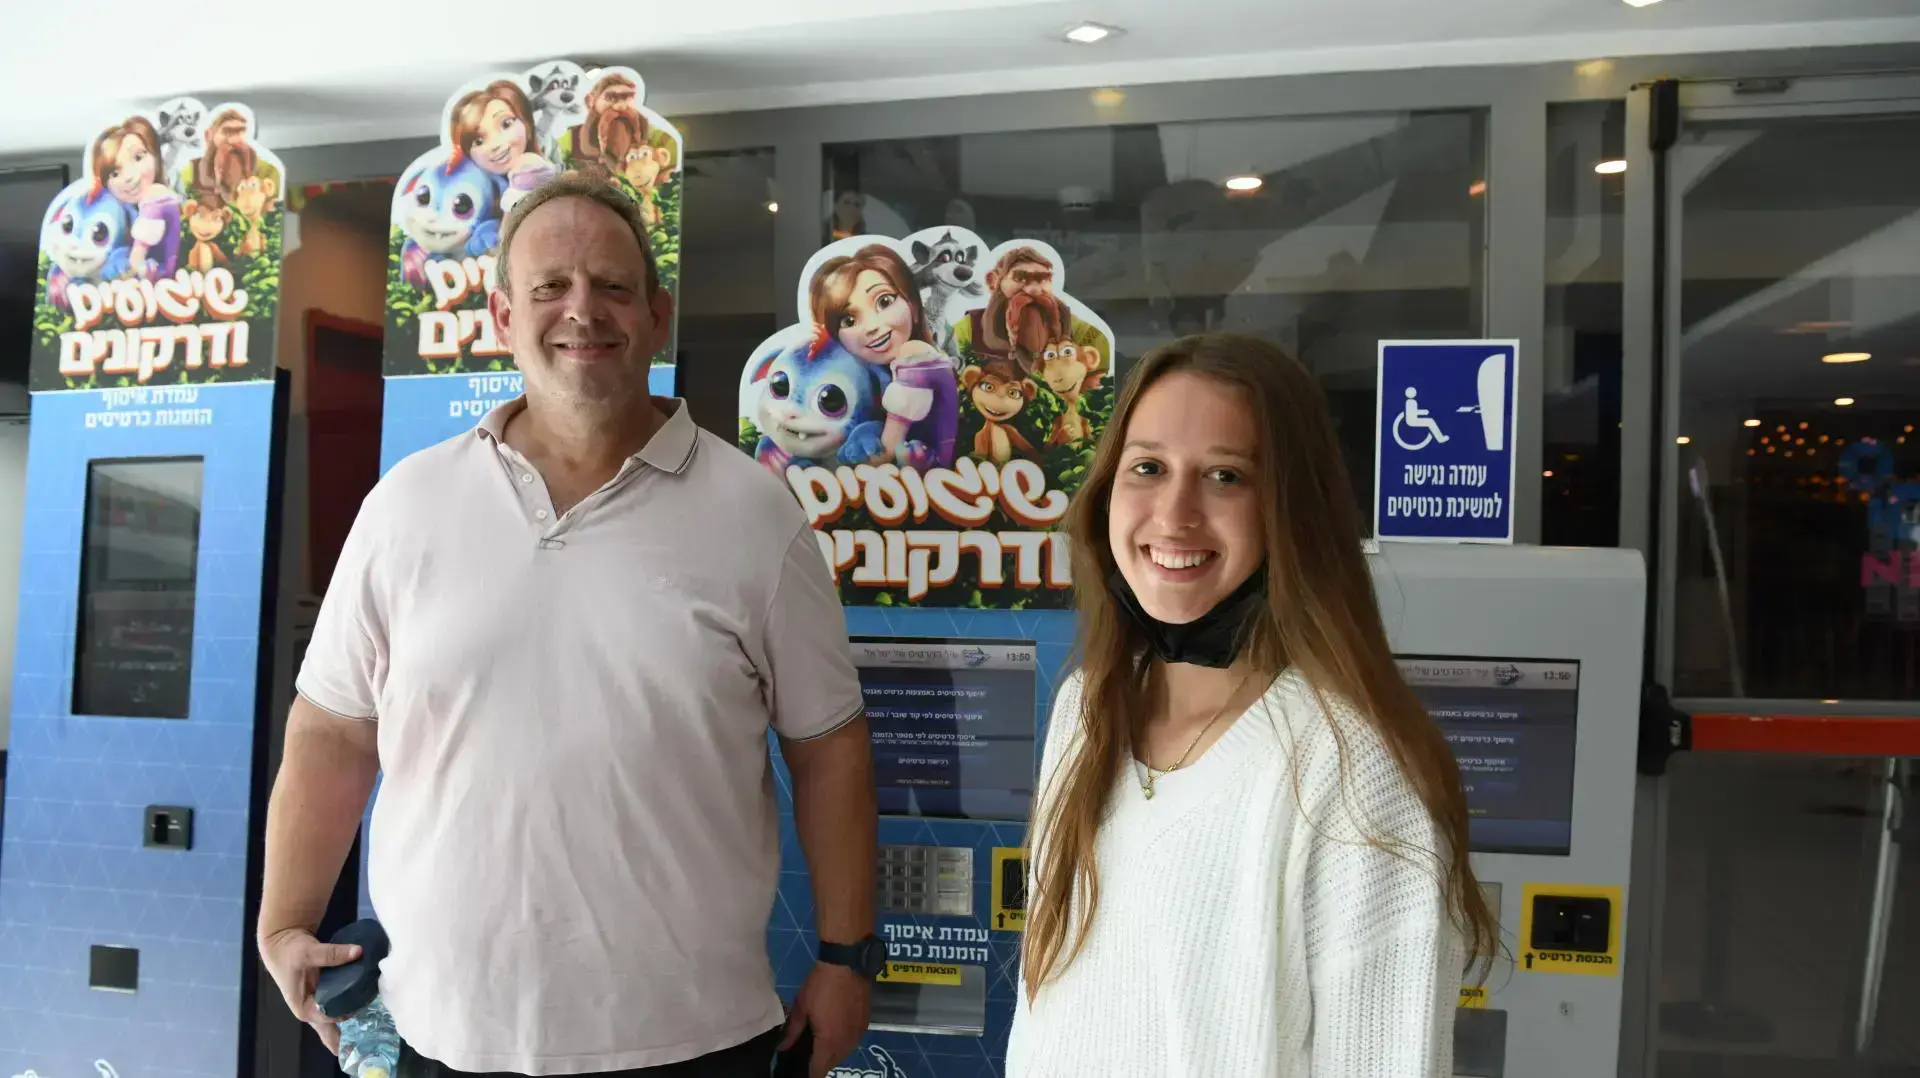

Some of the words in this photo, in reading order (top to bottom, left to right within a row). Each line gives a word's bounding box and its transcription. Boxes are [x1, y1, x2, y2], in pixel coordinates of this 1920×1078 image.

[67, 267, 249, 330] שיגועים
[59, 321, 249, 383] ודרקונים
[151, 387, 198, 405] עמדת
[468, 376, 523, 399] איסוף
[102, 389, 148, 410] איסוף
[84, 410, 152, 429] כרטיסים
[154, 408, 213, 426] הזמנות
[1403, 464, 1445, 486] נגישה
[1448, 464, 1488, 488] עמדה
[786, 456, 1070, 530] שיגועים
[1387, 495, 1443, 518] כרטיסים
[1446, 492, 1503, 519] למשיכת
[1006, 652, 1031, 662] 13:50
[883, 923, 934, 942] איסוף
[938, 927, 989, 943] עמדת
[928, 944, 989, 962] הזמנות
